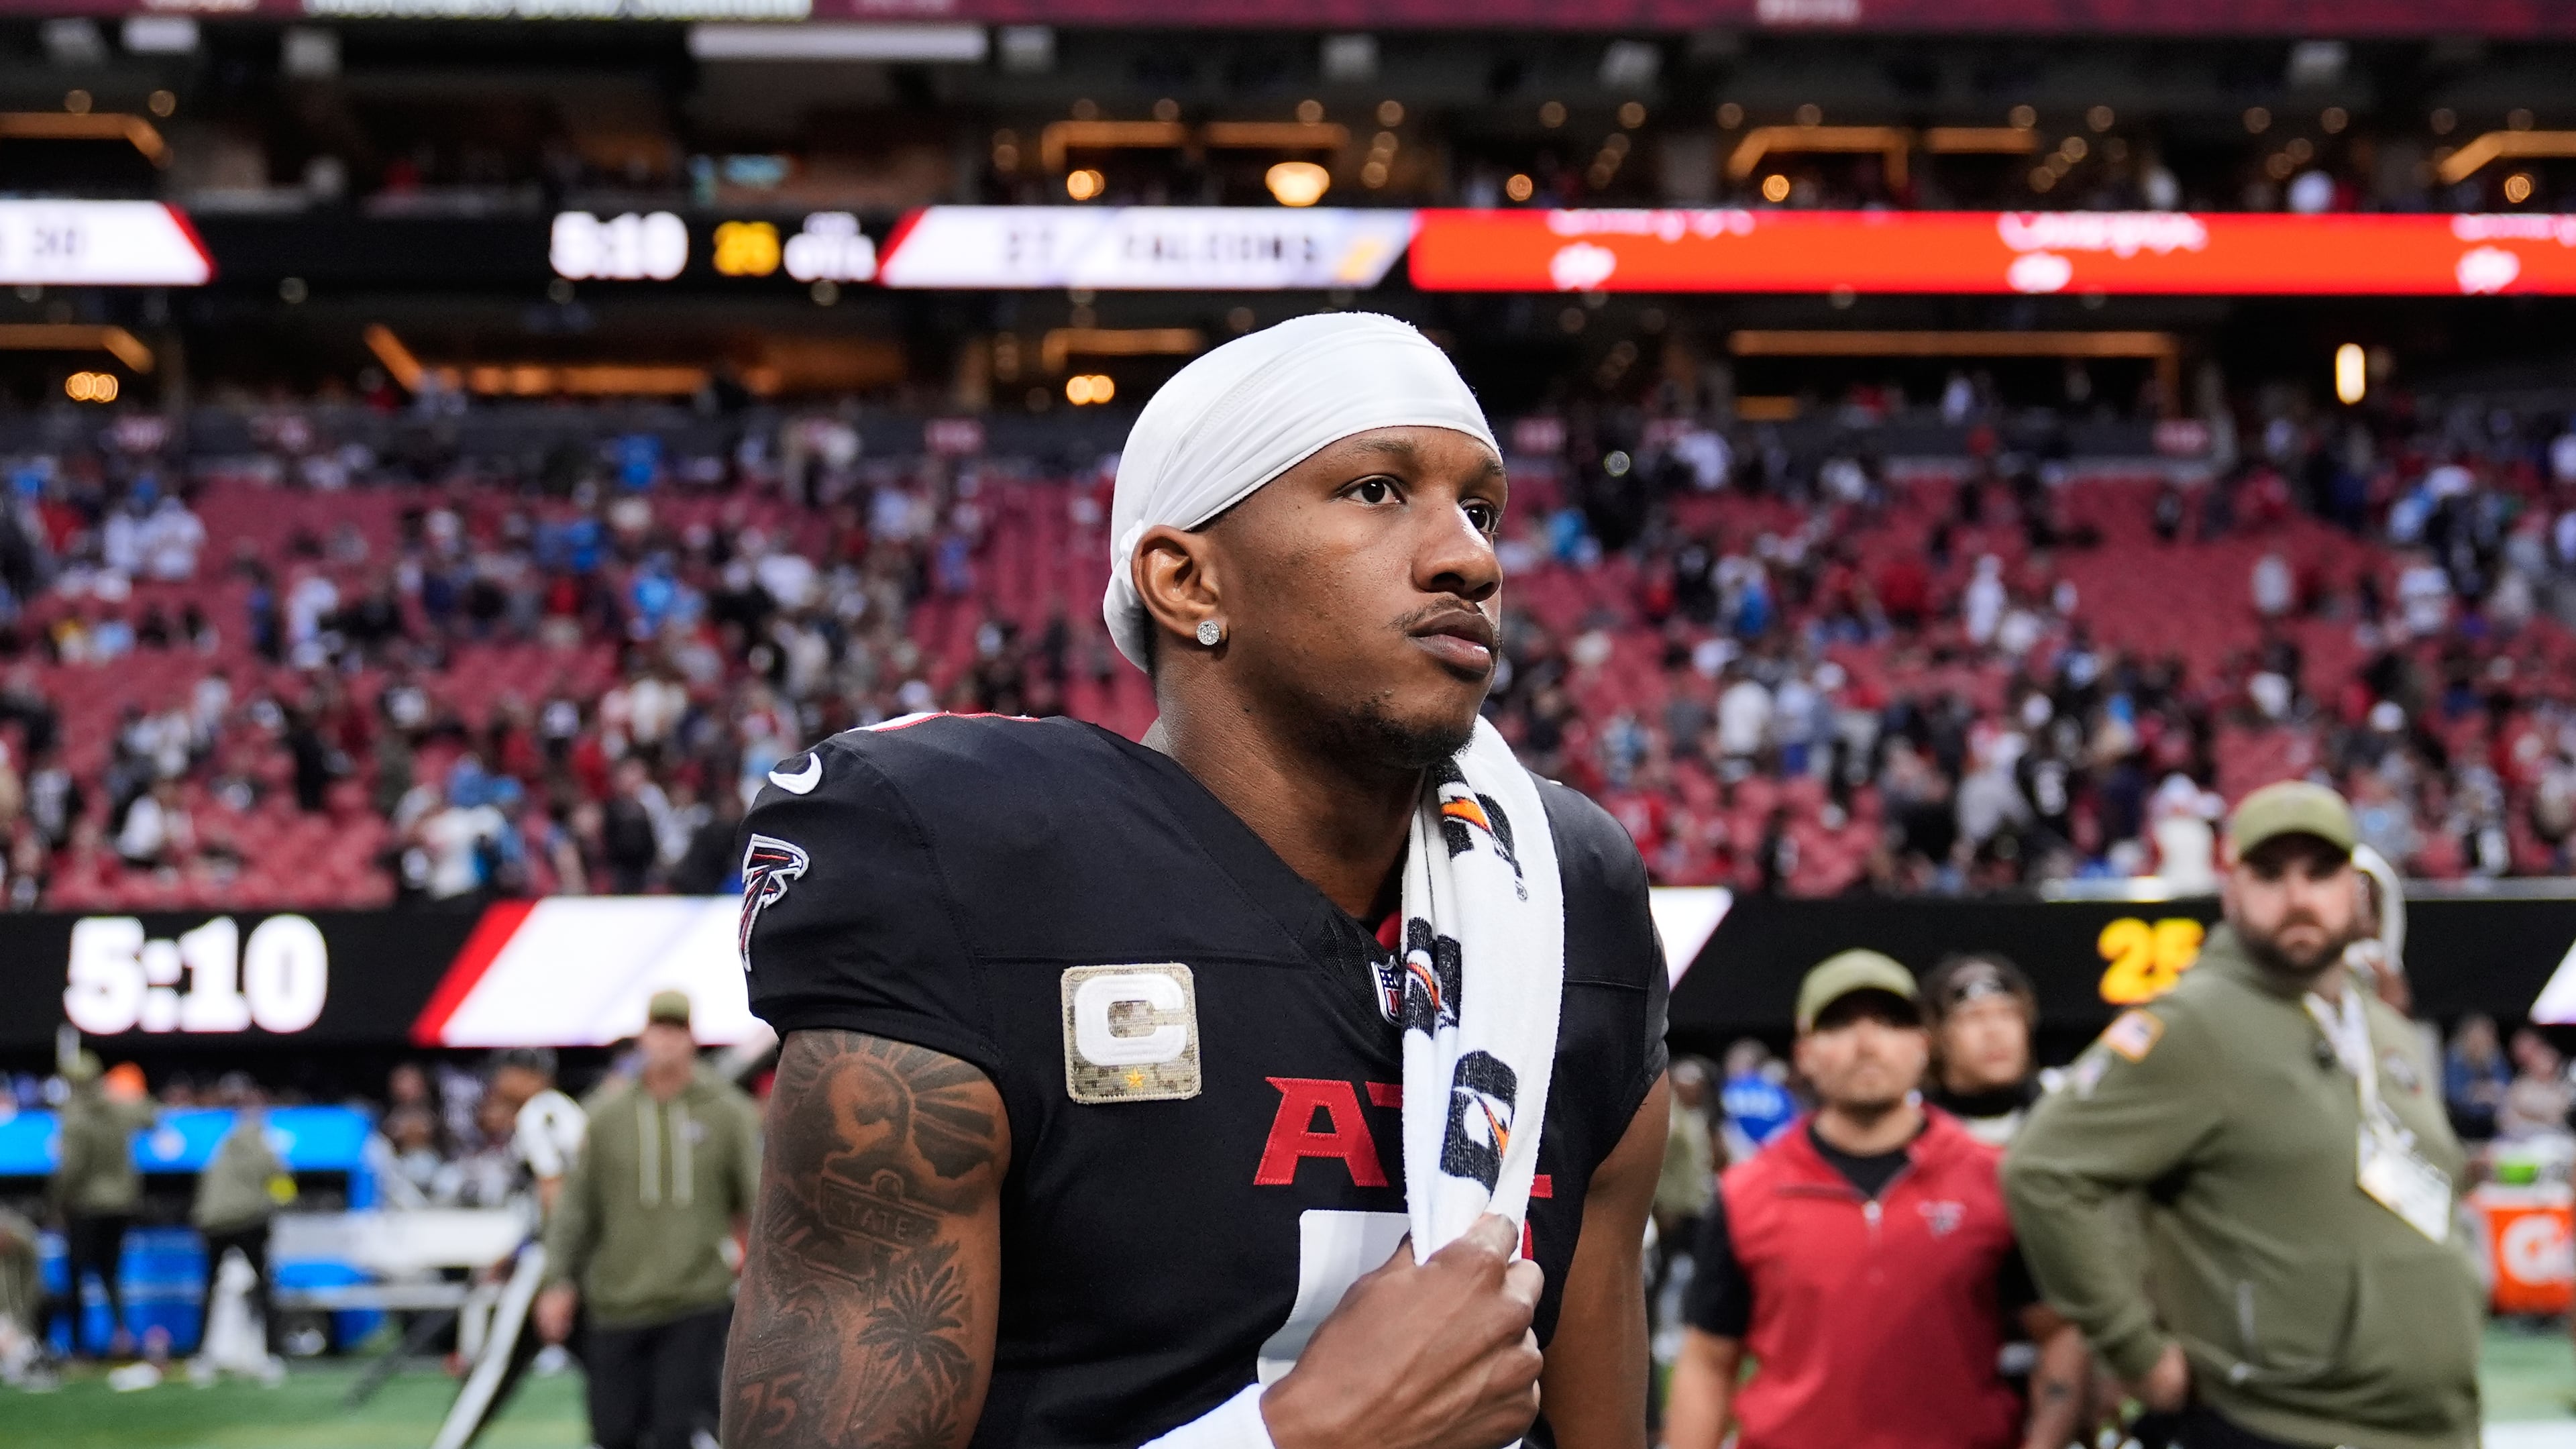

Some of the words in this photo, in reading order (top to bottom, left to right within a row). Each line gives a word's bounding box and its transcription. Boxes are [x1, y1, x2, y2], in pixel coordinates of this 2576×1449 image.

[64, 914, 328, 1034] 5:10
[2098, 917, 2205, 1005] 25
[1075, 974, 1188, 1065] C
